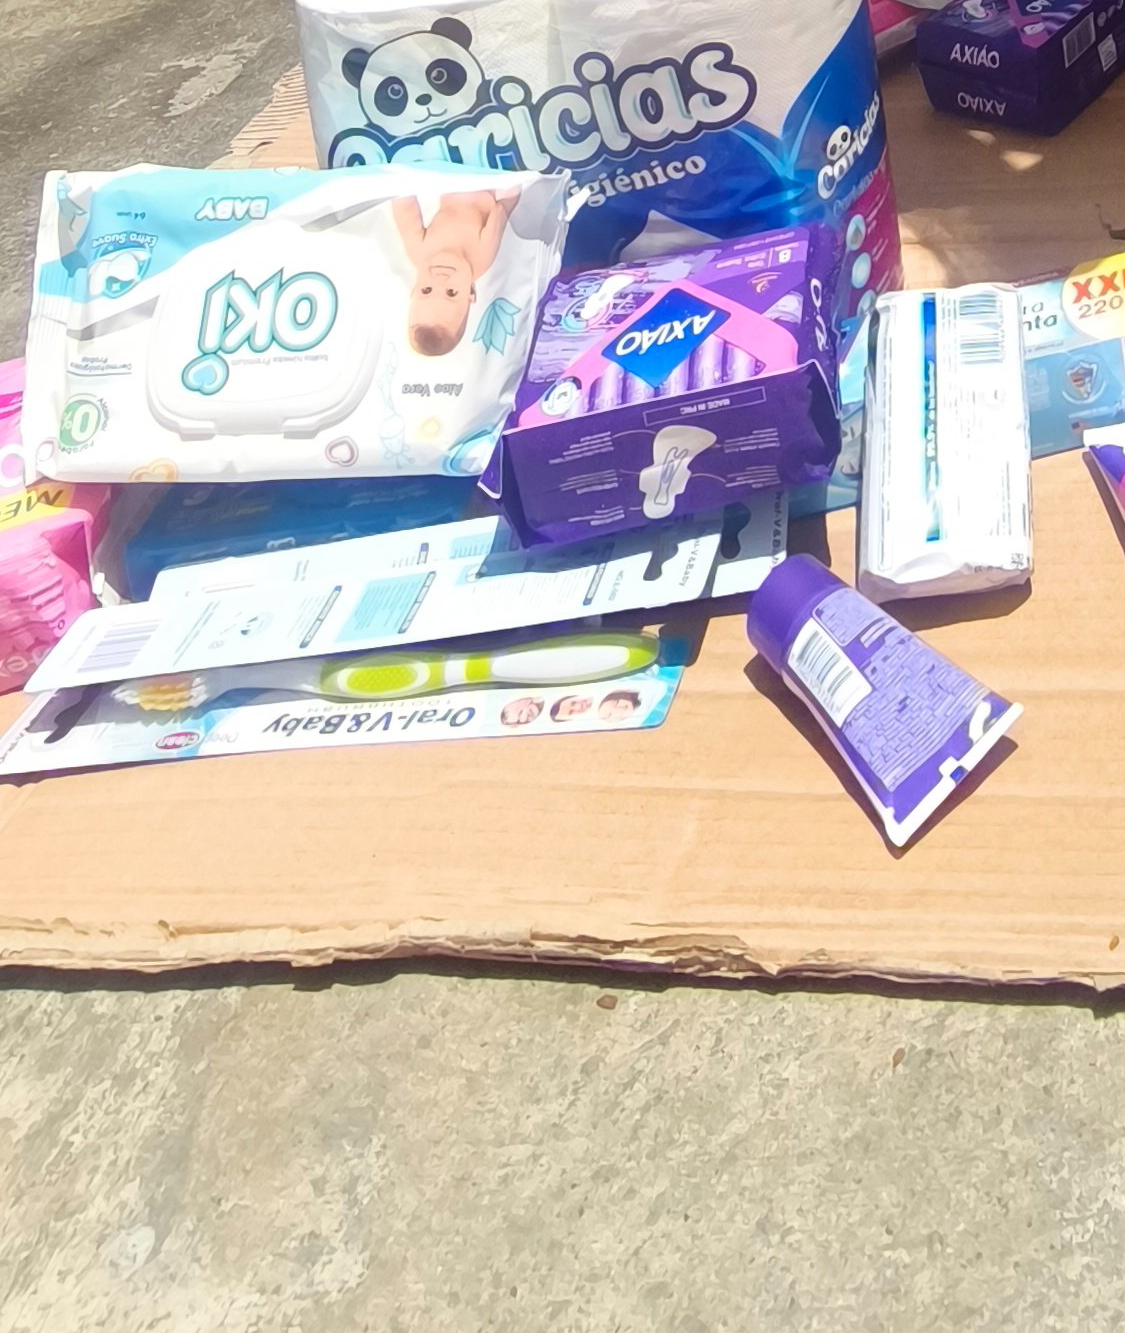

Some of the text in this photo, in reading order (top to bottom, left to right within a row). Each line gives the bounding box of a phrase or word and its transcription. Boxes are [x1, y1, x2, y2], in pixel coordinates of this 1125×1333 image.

[950, 43, 1000, 69] AXIÁO
[817, 90, 880, 200] Caricias
[569, 155, 707, 208] igiénico
[195, 196, 269, 222] BABY
[1078, 295, 1124, 320] 220
[616, 308, 716, 357] AXIÁO
[1023, 314, 1058, 332] nta
[401, 383, 464, 397] Aloe Vera
[0, 488, 63, 522] ME
[261, 707, 477, 737] Oral-V&Baby
